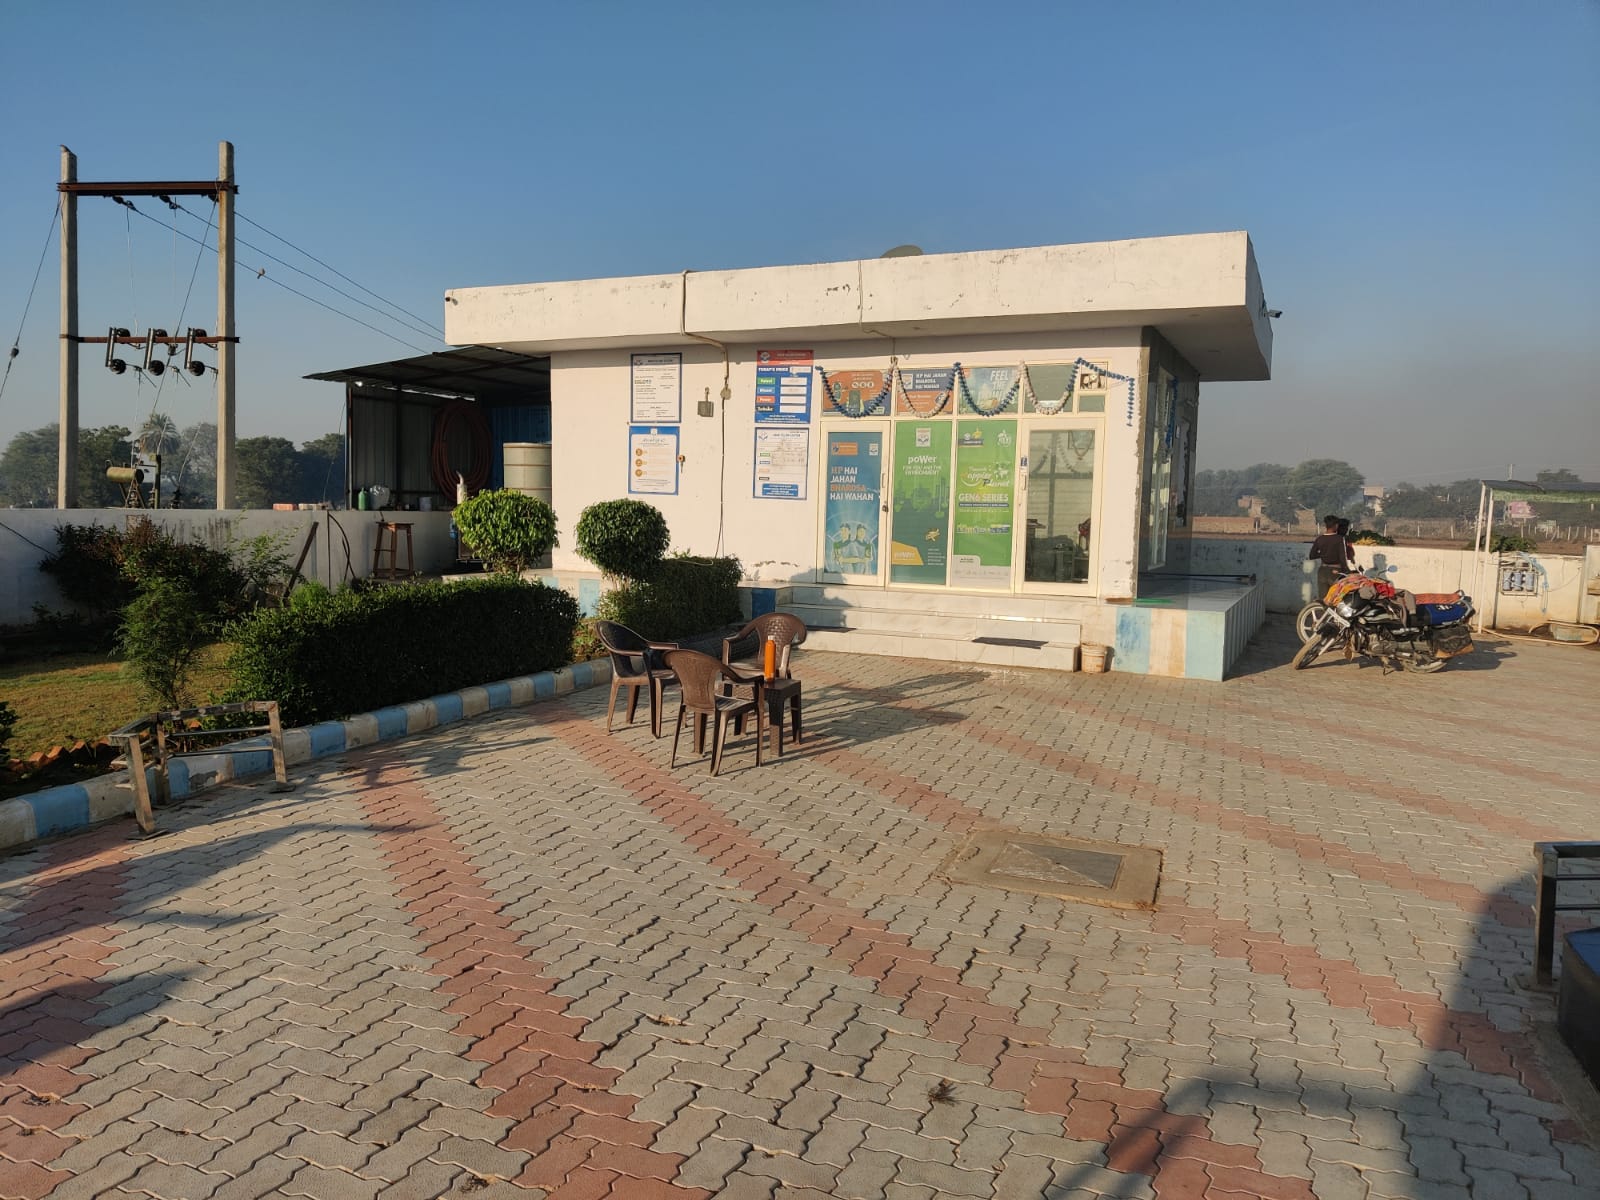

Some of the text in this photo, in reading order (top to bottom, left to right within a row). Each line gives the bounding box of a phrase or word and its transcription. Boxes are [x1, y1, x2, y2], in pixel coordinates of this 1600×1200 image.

[990, 370, 1009, 381] FEEL
[844, 466, 858, 475] HAI
[831, 475, 856, 483] JAHAN
[830, 492, 874, 501] HAI WAHAN
[982, 493, 1009, 502] SERIES
